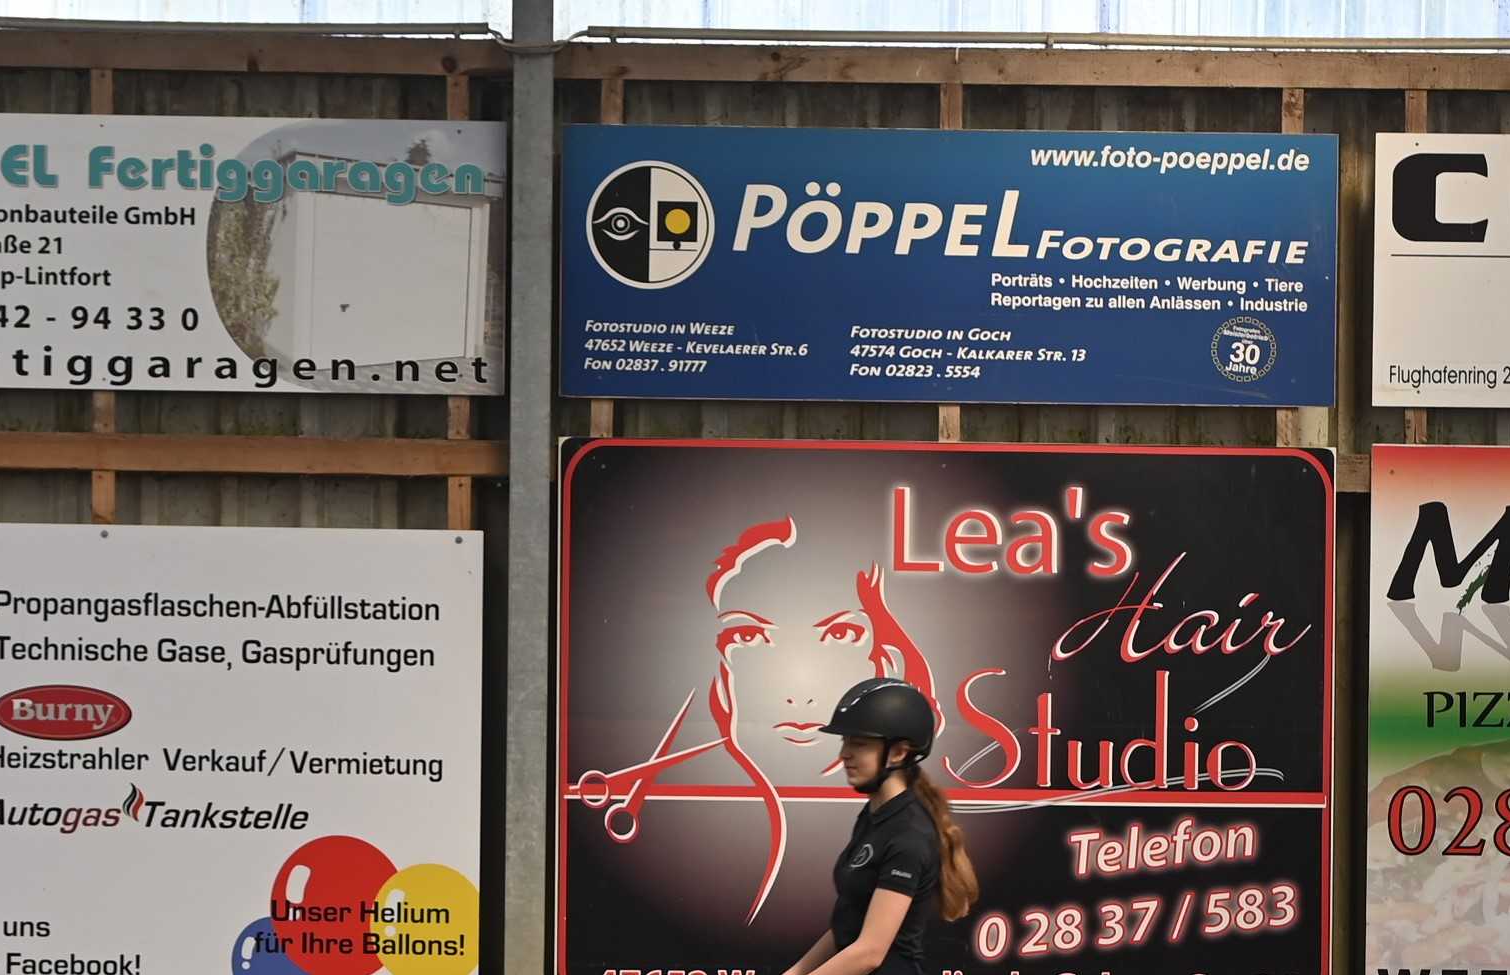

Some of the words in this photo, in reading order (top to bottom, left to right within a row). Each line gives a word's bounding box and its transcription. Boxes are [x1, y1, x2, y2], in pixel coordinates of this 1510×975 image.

[1031, 146, 1309, 175] www.foto-poeppel.de
[89, 144, 485, 205] Fertiggaragen
[125, 206, 195, 225] GmbH
[38, 237, 61, 254] 21
[992, 273, 1052, 287] Porträts
[1072, 275, 1157, 289] Hochzeiten
[1177, 277, 1245, 294] Werbung
[1265, 279, 1303, 292] Tiere
[991, 293, 1080, 310] Reportagen
[1086, 298, 1103, 307] zu
[1108, 295, 1145, 308] allen
[1150, 296, 1220, 310] Anlässen
[1241, 298, 1307, 312] Industrie
[71, 306, 111, 329] 94
[127, 307, 164, 330] 33
[182, 308, 198, 331] 0
[585, 339, 626, 351] 47652
[850, 345, 895, 357] 47574
[1072, 349, 1086, 361] 13
[1230, 342, 1260, 365] 30
[1225, 362, 1257, 374] Jahre
[1390, 365, 1497, 389] Flughafenring
[893, 487, 1132, 577] Lea's
[1049, 552, 1312, 667] Hair
[158, 638, 231, 670] Gase,
[242, 640, 434, 672] Gasprüfungen
[12, 697, 114, 731] Burny
[944, 668, 1260, 789] Studio
[143, 801, 309, 830] Tankstelle
[1069, 820, 1256, 879] Telefon
[271, 900, 353, 924] Unser
[360, 901, 451, 926] Helium
[978, 915, 1008, 959] 0
[1019, 910, 1083, 954] 28
[1095, 902, 1160, 948] 37
[1204, 886, 1298, 934] 583
[4, 921, 50, 937] uns
[254, 931, 293, 956] für
[302, 932, 354, 956] Ihre
[362, 932, 465, 957] Ballons!
[7, 953, 140, 975] Facebook!
